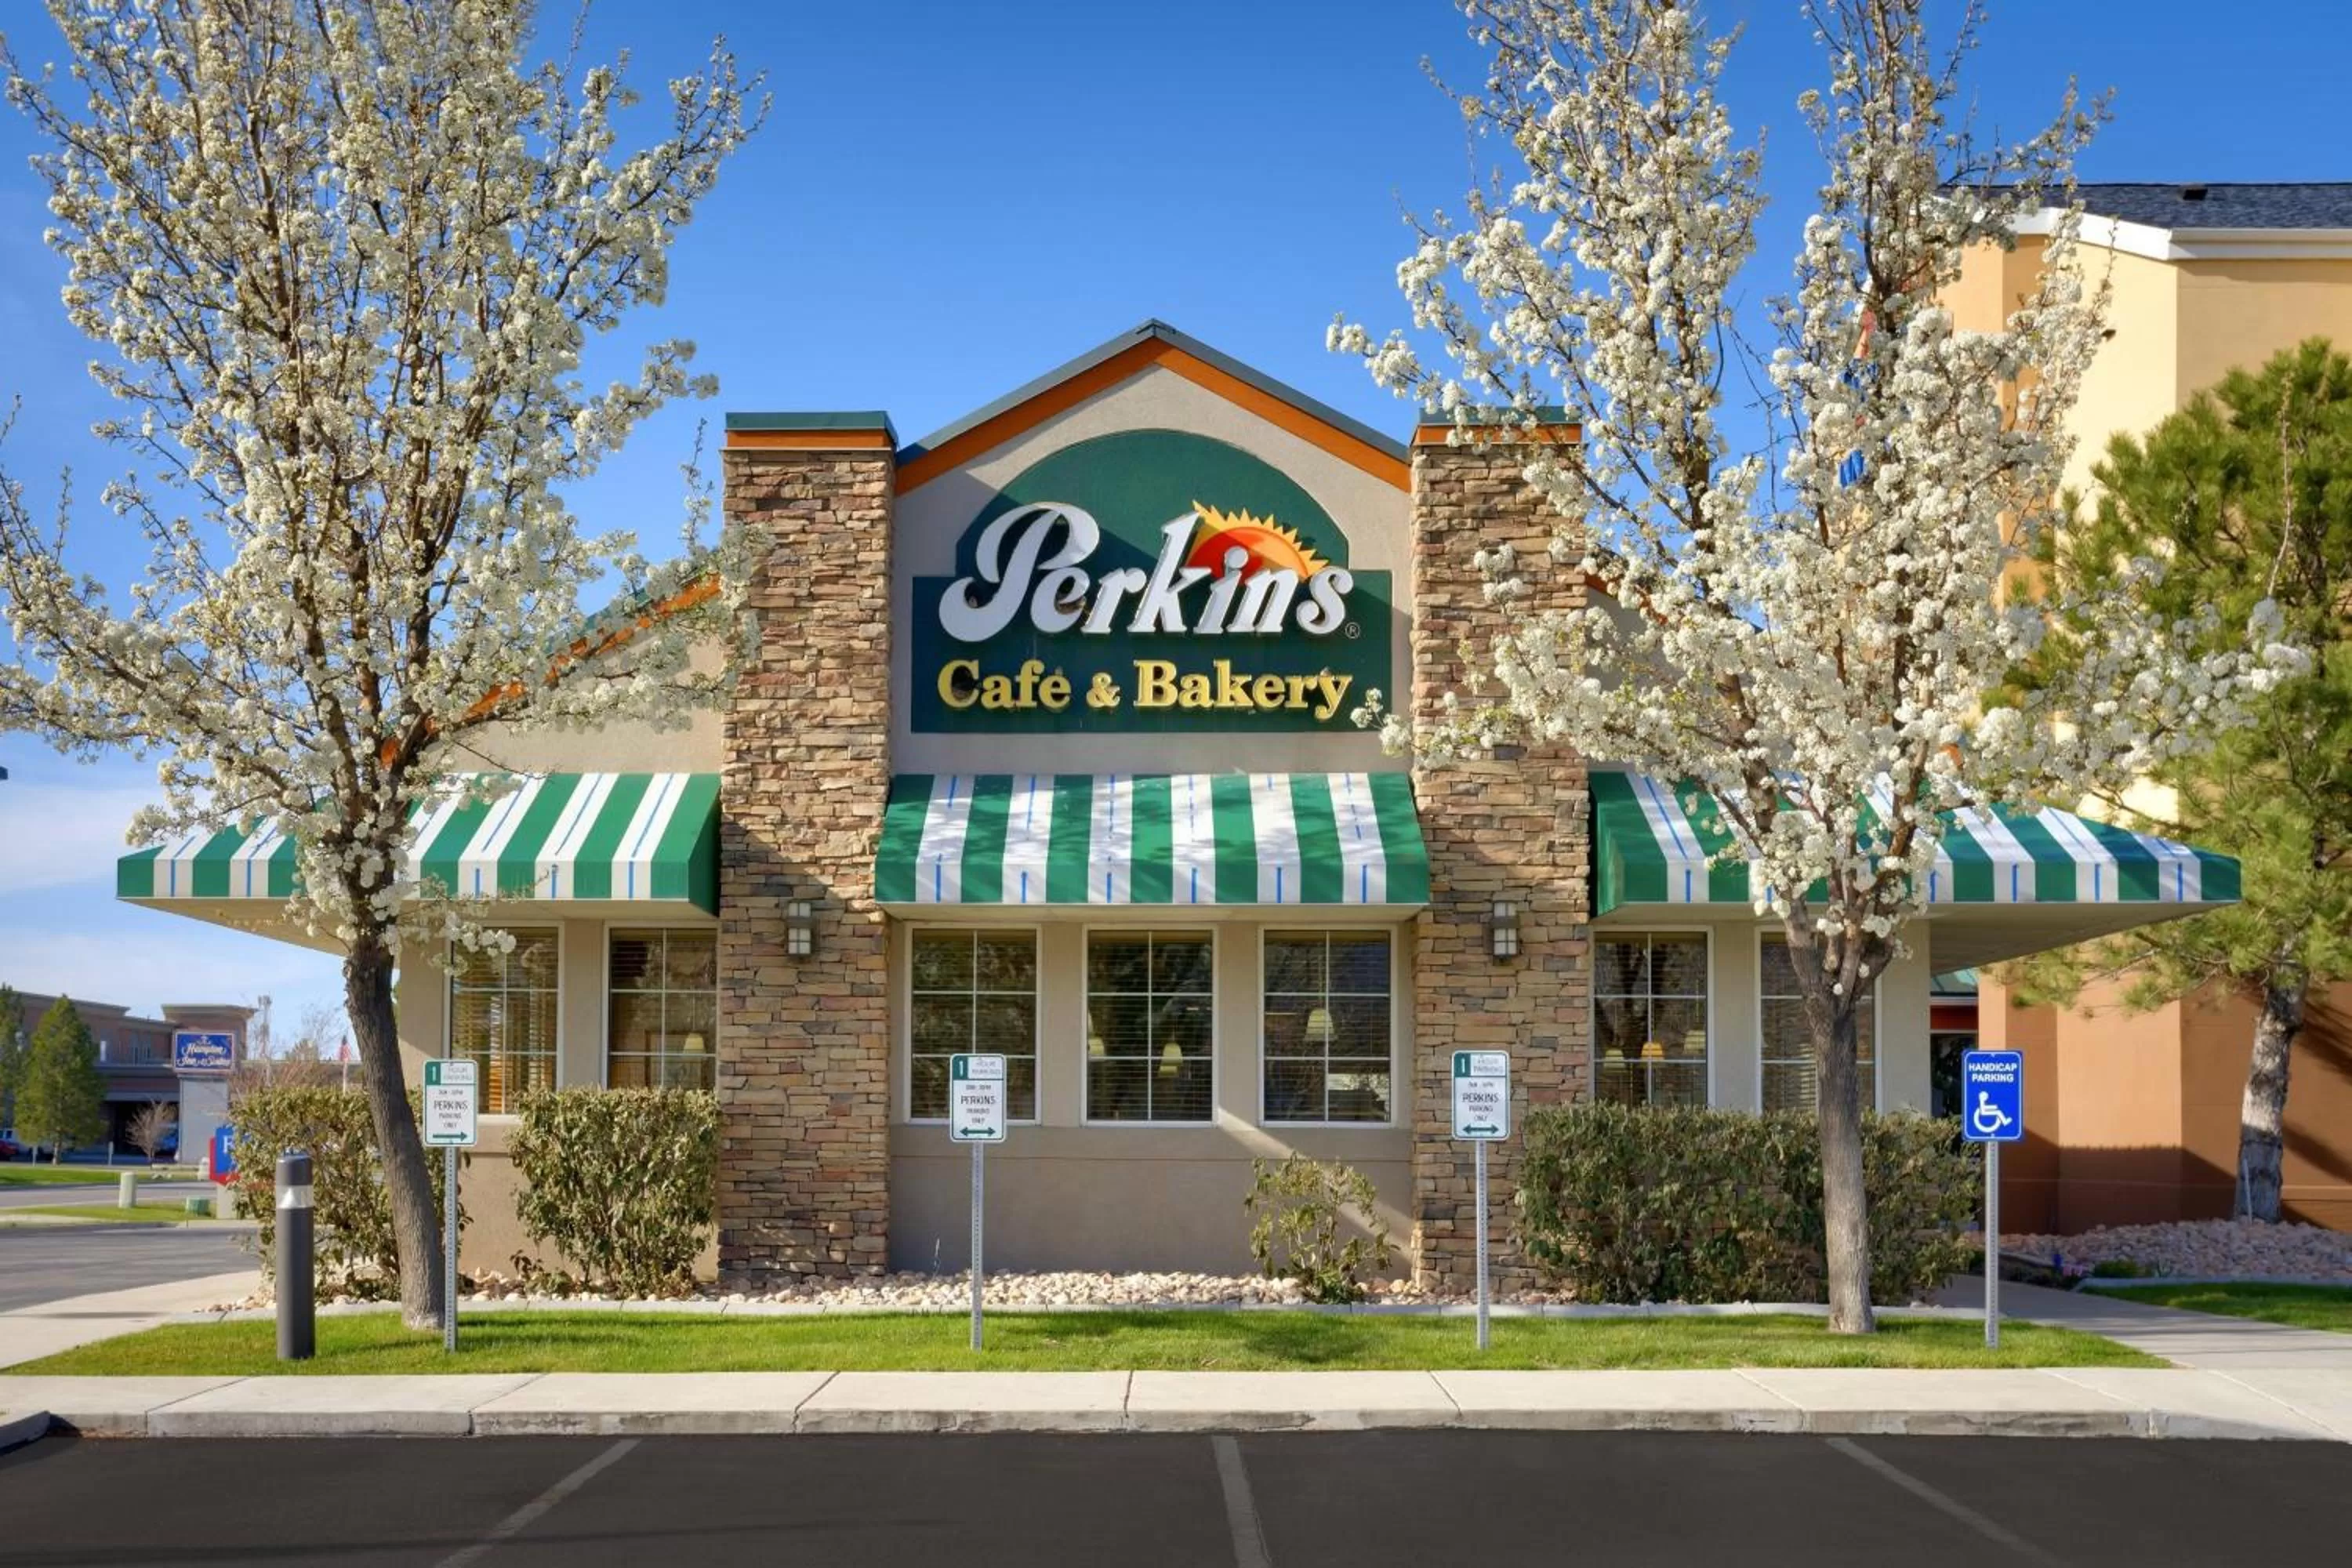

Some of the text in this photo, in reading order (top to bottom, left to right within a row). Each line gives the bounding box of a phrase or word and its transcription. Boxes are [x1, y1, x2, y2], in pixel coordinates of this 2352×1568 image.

[938, 502, 1353, 643] Perkins
[1087, 672, 1121, 708] &
[1134, 659, 1352, 720] Bakery
[1969, 1062, 2017, 1072] HANDICAP
[1972, 1073, 2014, 1083] PARKING
[960, 1095, 996, 1105] PERKINS
[1462, 1092, 1500, 1103] PERKINS
[434, 1100, 468, 1111] PERKINS
